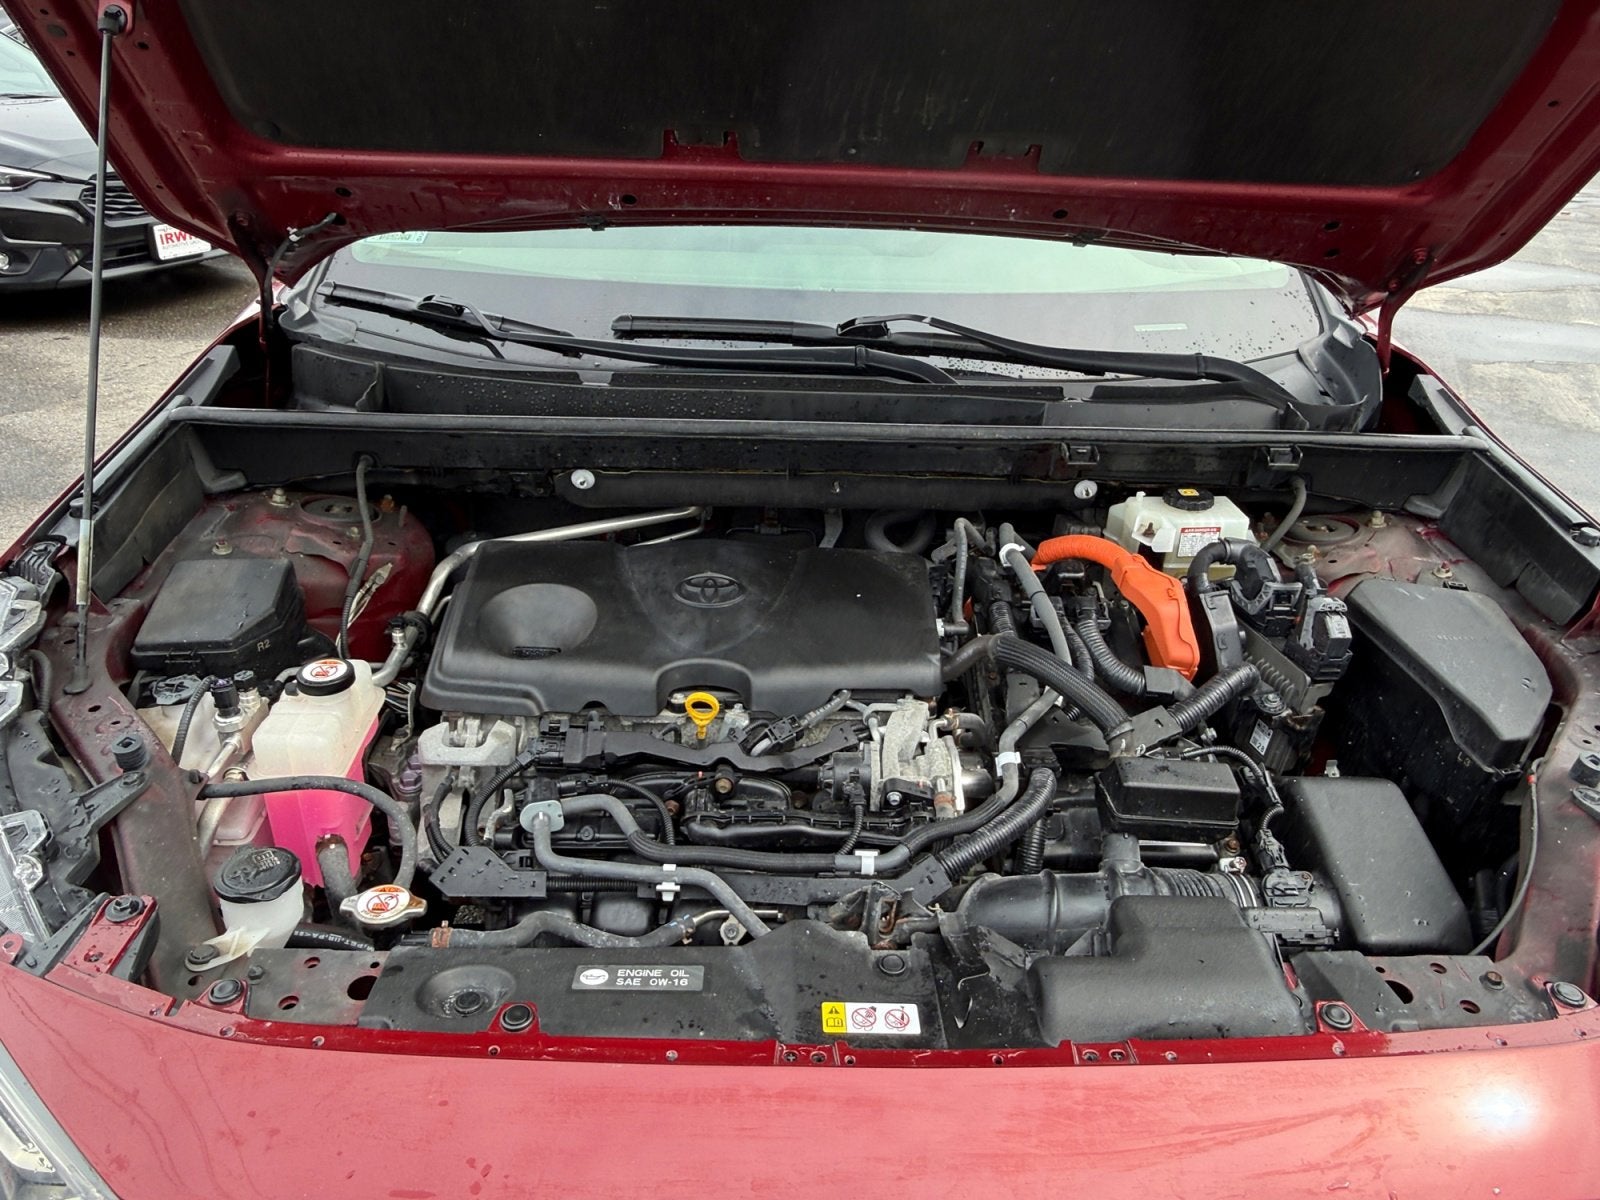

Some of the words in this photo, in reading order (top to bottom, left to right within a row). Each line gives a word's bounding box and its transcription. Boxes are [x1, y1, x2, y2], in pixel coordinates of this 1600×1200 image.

[257, 639, 271, 652] R2
[617, 968, 663, 977] ENGINE
[670, 969, 690, 977] OIL
[615, 978, 642, 986] SAE
[649, 978, 689, 986] 0W-16
